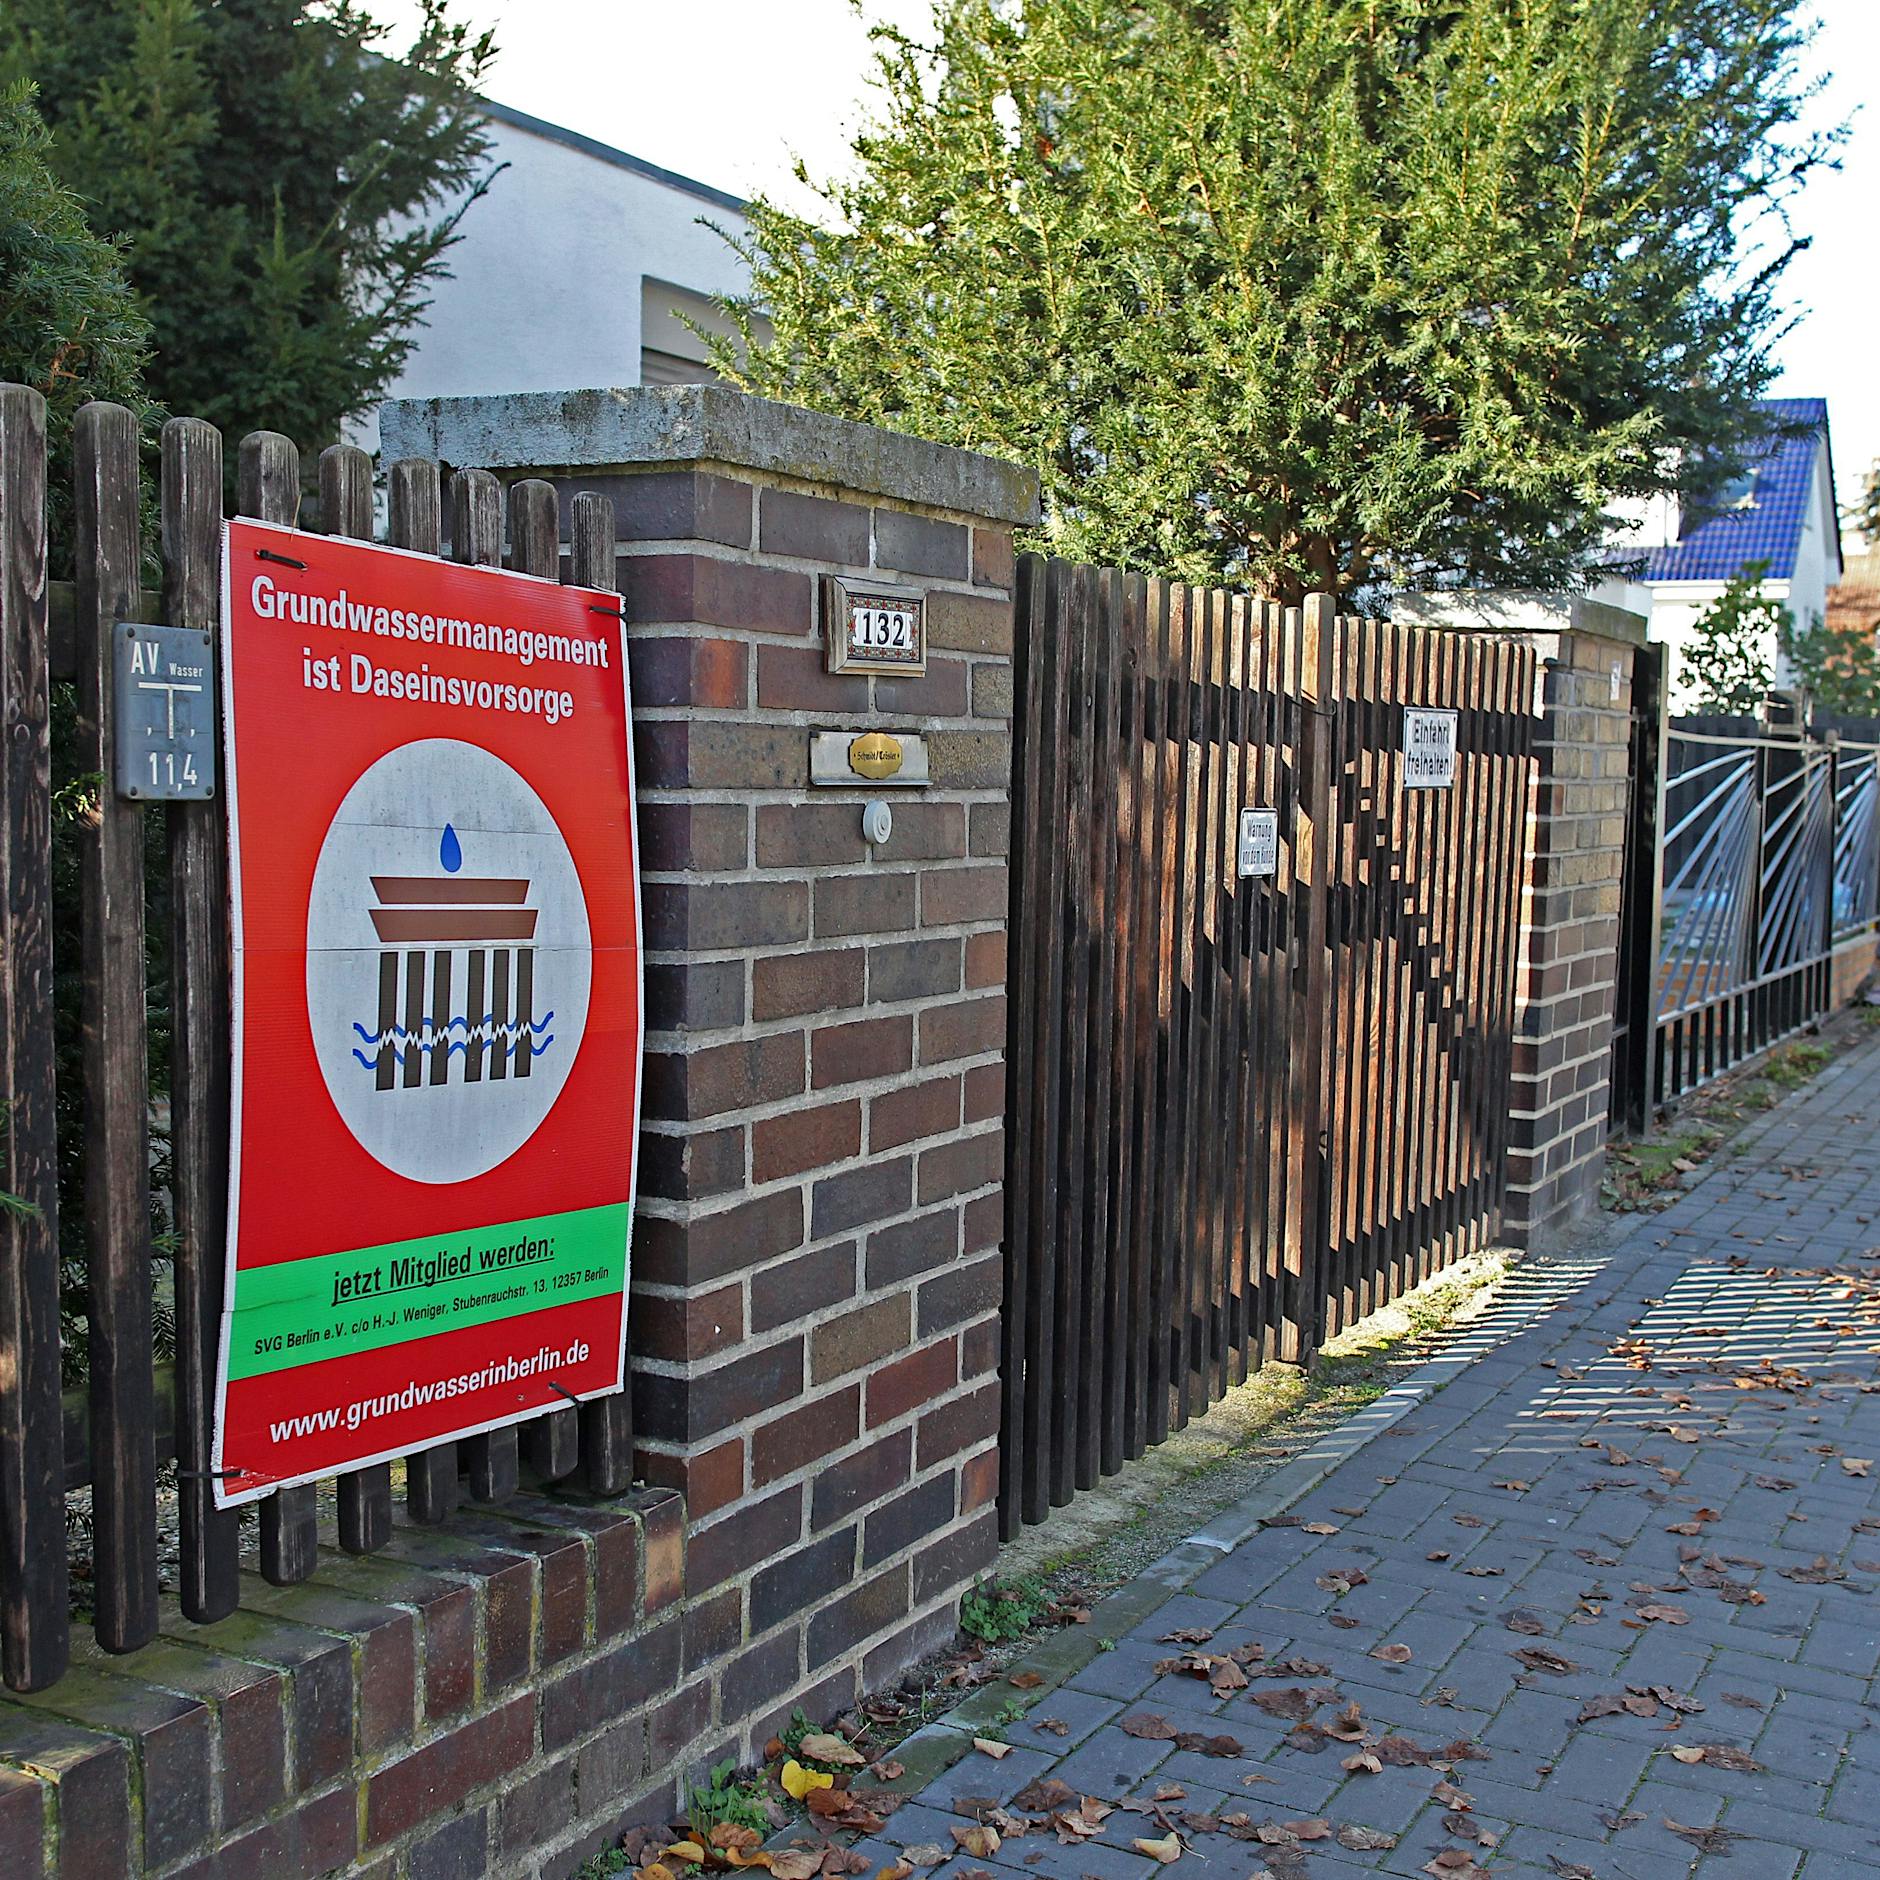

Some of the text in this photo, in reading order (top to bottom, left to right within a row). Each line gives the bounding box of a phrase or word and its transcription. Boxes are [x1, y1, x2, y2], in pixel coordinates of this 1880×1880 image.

[251, 575, 610, 669] Grundwassermanagement
[863, 611, 905, 647] 132
[130, 641, 204, 678] AV Wasser
[303, 647, 574, 725] ist Daseinsvorsorge
[1413, 718, 1450, 744] Einfahrt
[149, 751, 198, 793] 11,4
[1247, 819, 1272, 843] Warnung
[331, 1236, 555, 1307] jetzt Mitglied werden:
[254, 1266, 609, 1355] SVG Berlin e.V. c/o H.-J. Weniger, Stubenrauchstr. 13, 12357 Berlin
[269, 1338, 590, 1443] www.grundwasserinberlin.de
